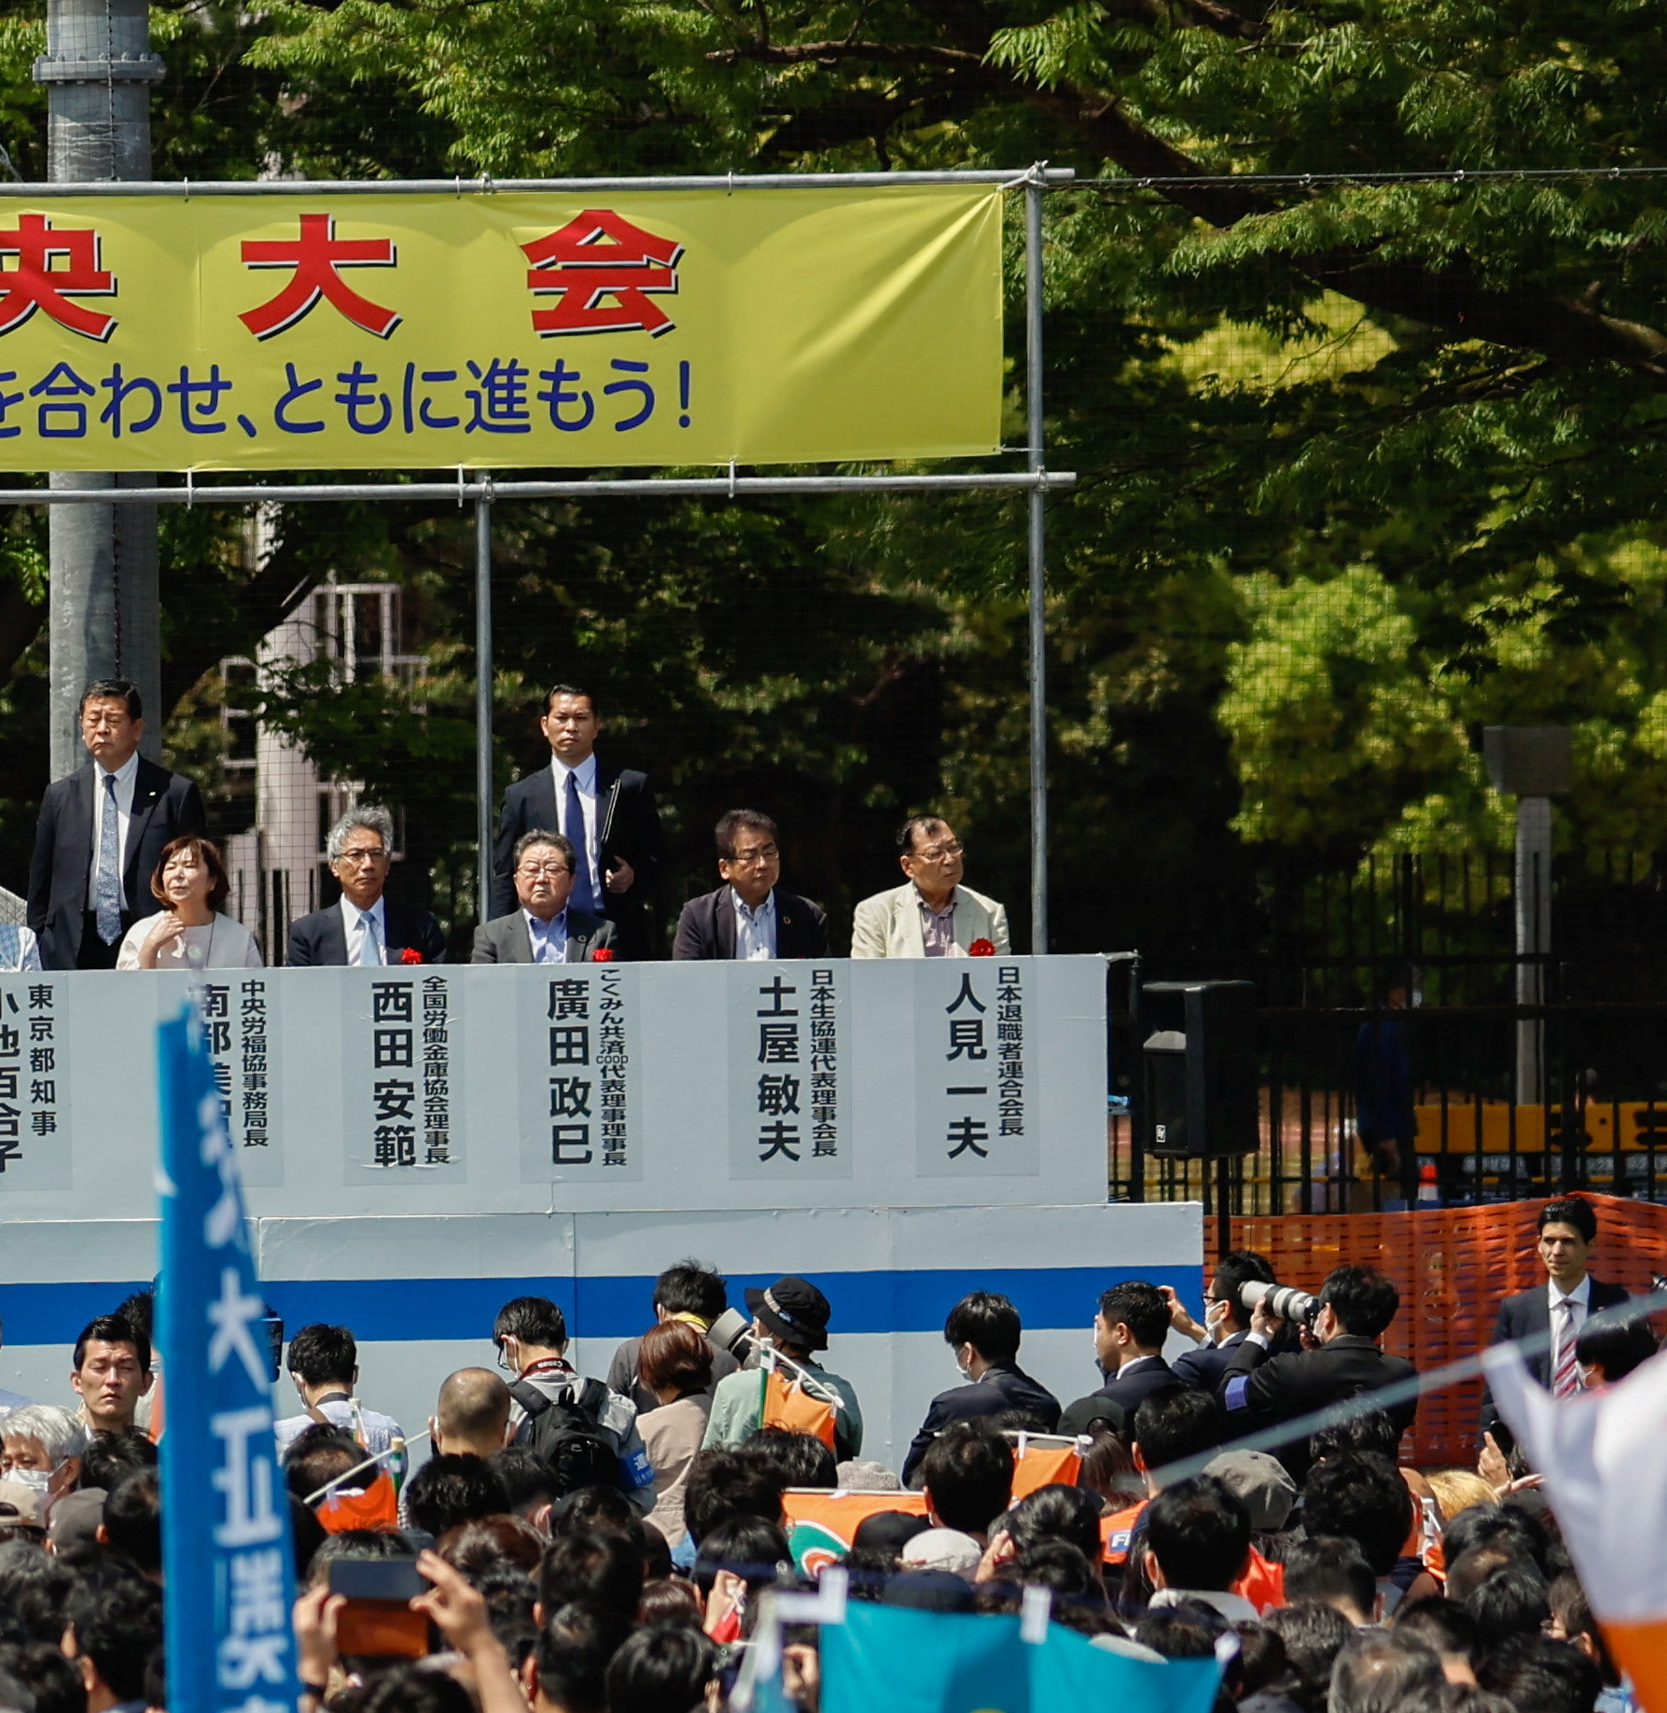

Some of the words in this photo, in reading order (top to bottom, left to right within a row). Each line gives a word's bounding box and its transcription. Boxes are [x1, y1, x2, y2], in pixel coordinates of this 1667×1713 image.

[28, 983, 57, 1136] 東京都知事
[240, 978, 269, 1147] 中央労福協事務局長
[371, 980, 416, 1167] 西田安範
[422, 975, 450, 1164] 全国労働金庫協会理事長
[756, 976, 801, 1162] 土屋敏夫
[809, 969, 838, 1158] 日本生協連代表理事会長
[945, 972, 989, 1160] 人見一夫
[996, 966, 1025, 1137] 日本退職者連合会長
